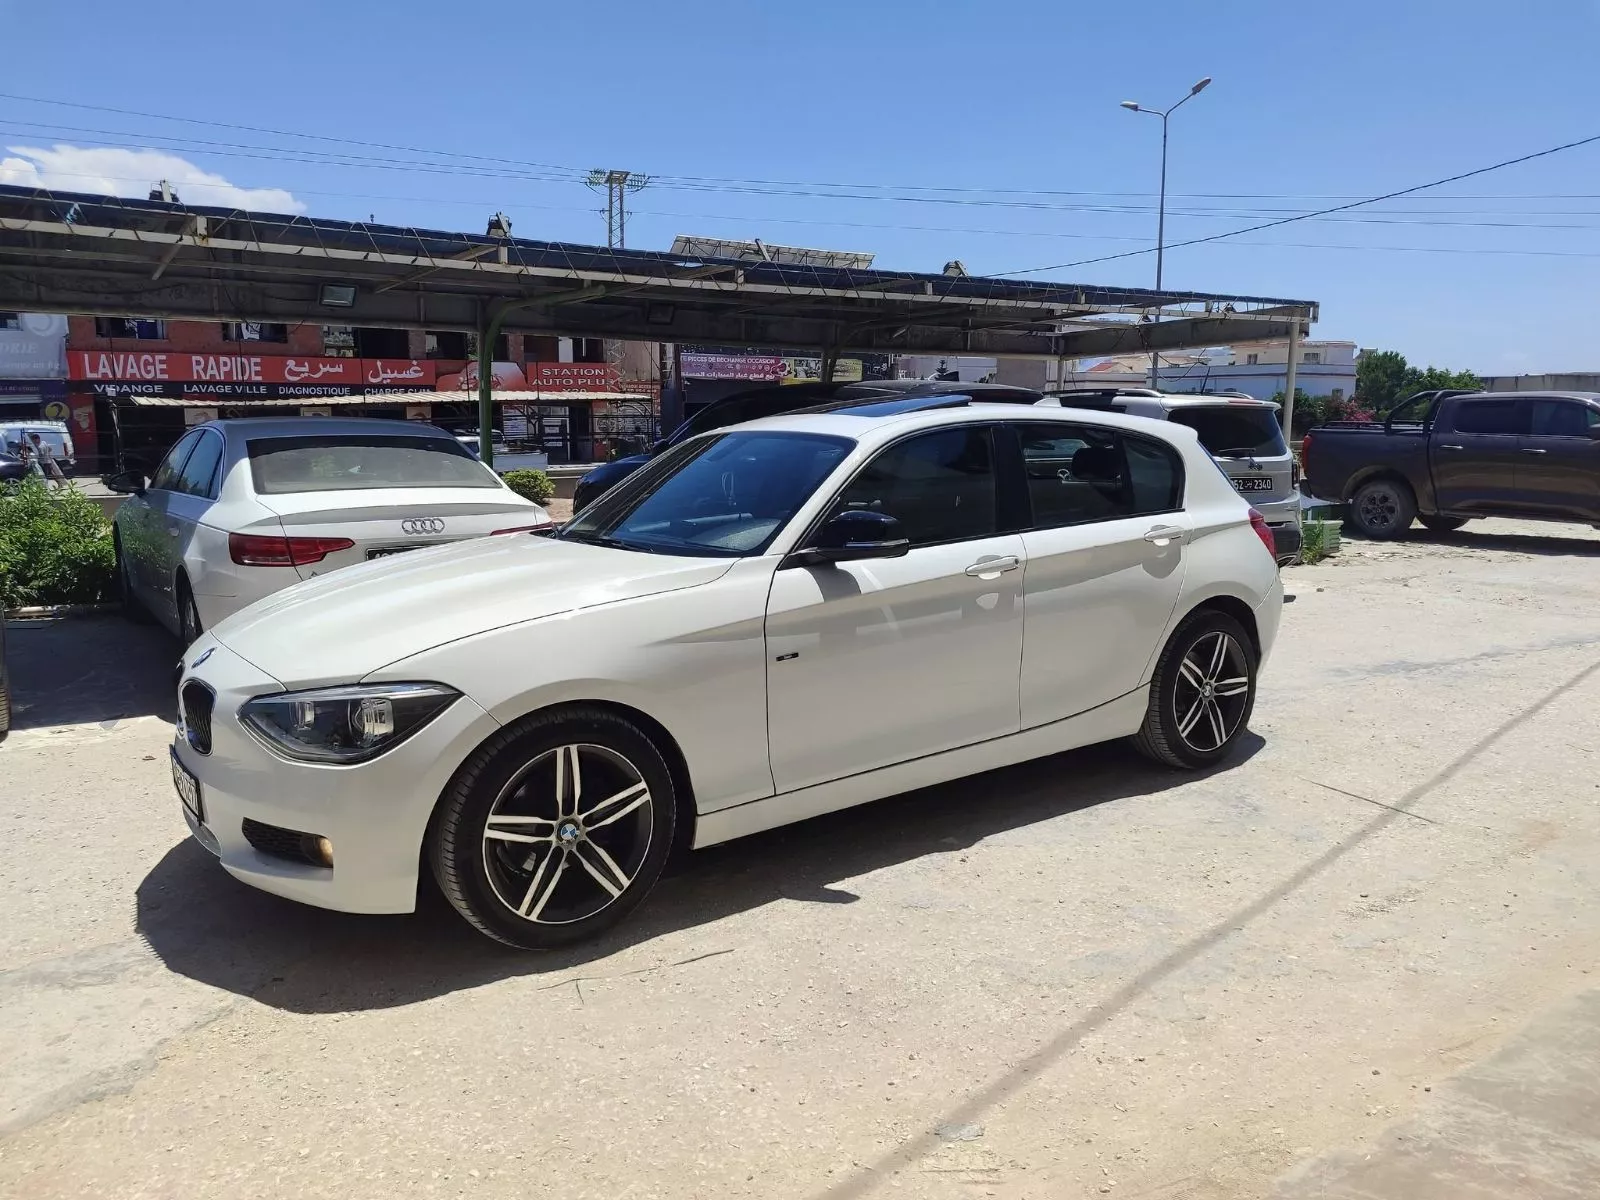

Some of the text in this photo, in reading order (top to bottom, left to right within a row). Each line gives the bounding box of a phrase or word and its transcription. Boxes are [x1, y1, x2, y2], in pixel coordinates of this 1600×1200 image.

[84, 353, 263, 381] LAVAGE RAPIDE
[284, 359, 425, 384] غسيل سريع
[542, 368, 604, 376] STATION
[532, 378, 574, 386] AUTO
[184, 384, 232, 393] LAVAGE
[278, 386, 350, 396] DIAGNOSTIQUE
[1254, 479, 1271, 490] 2340
